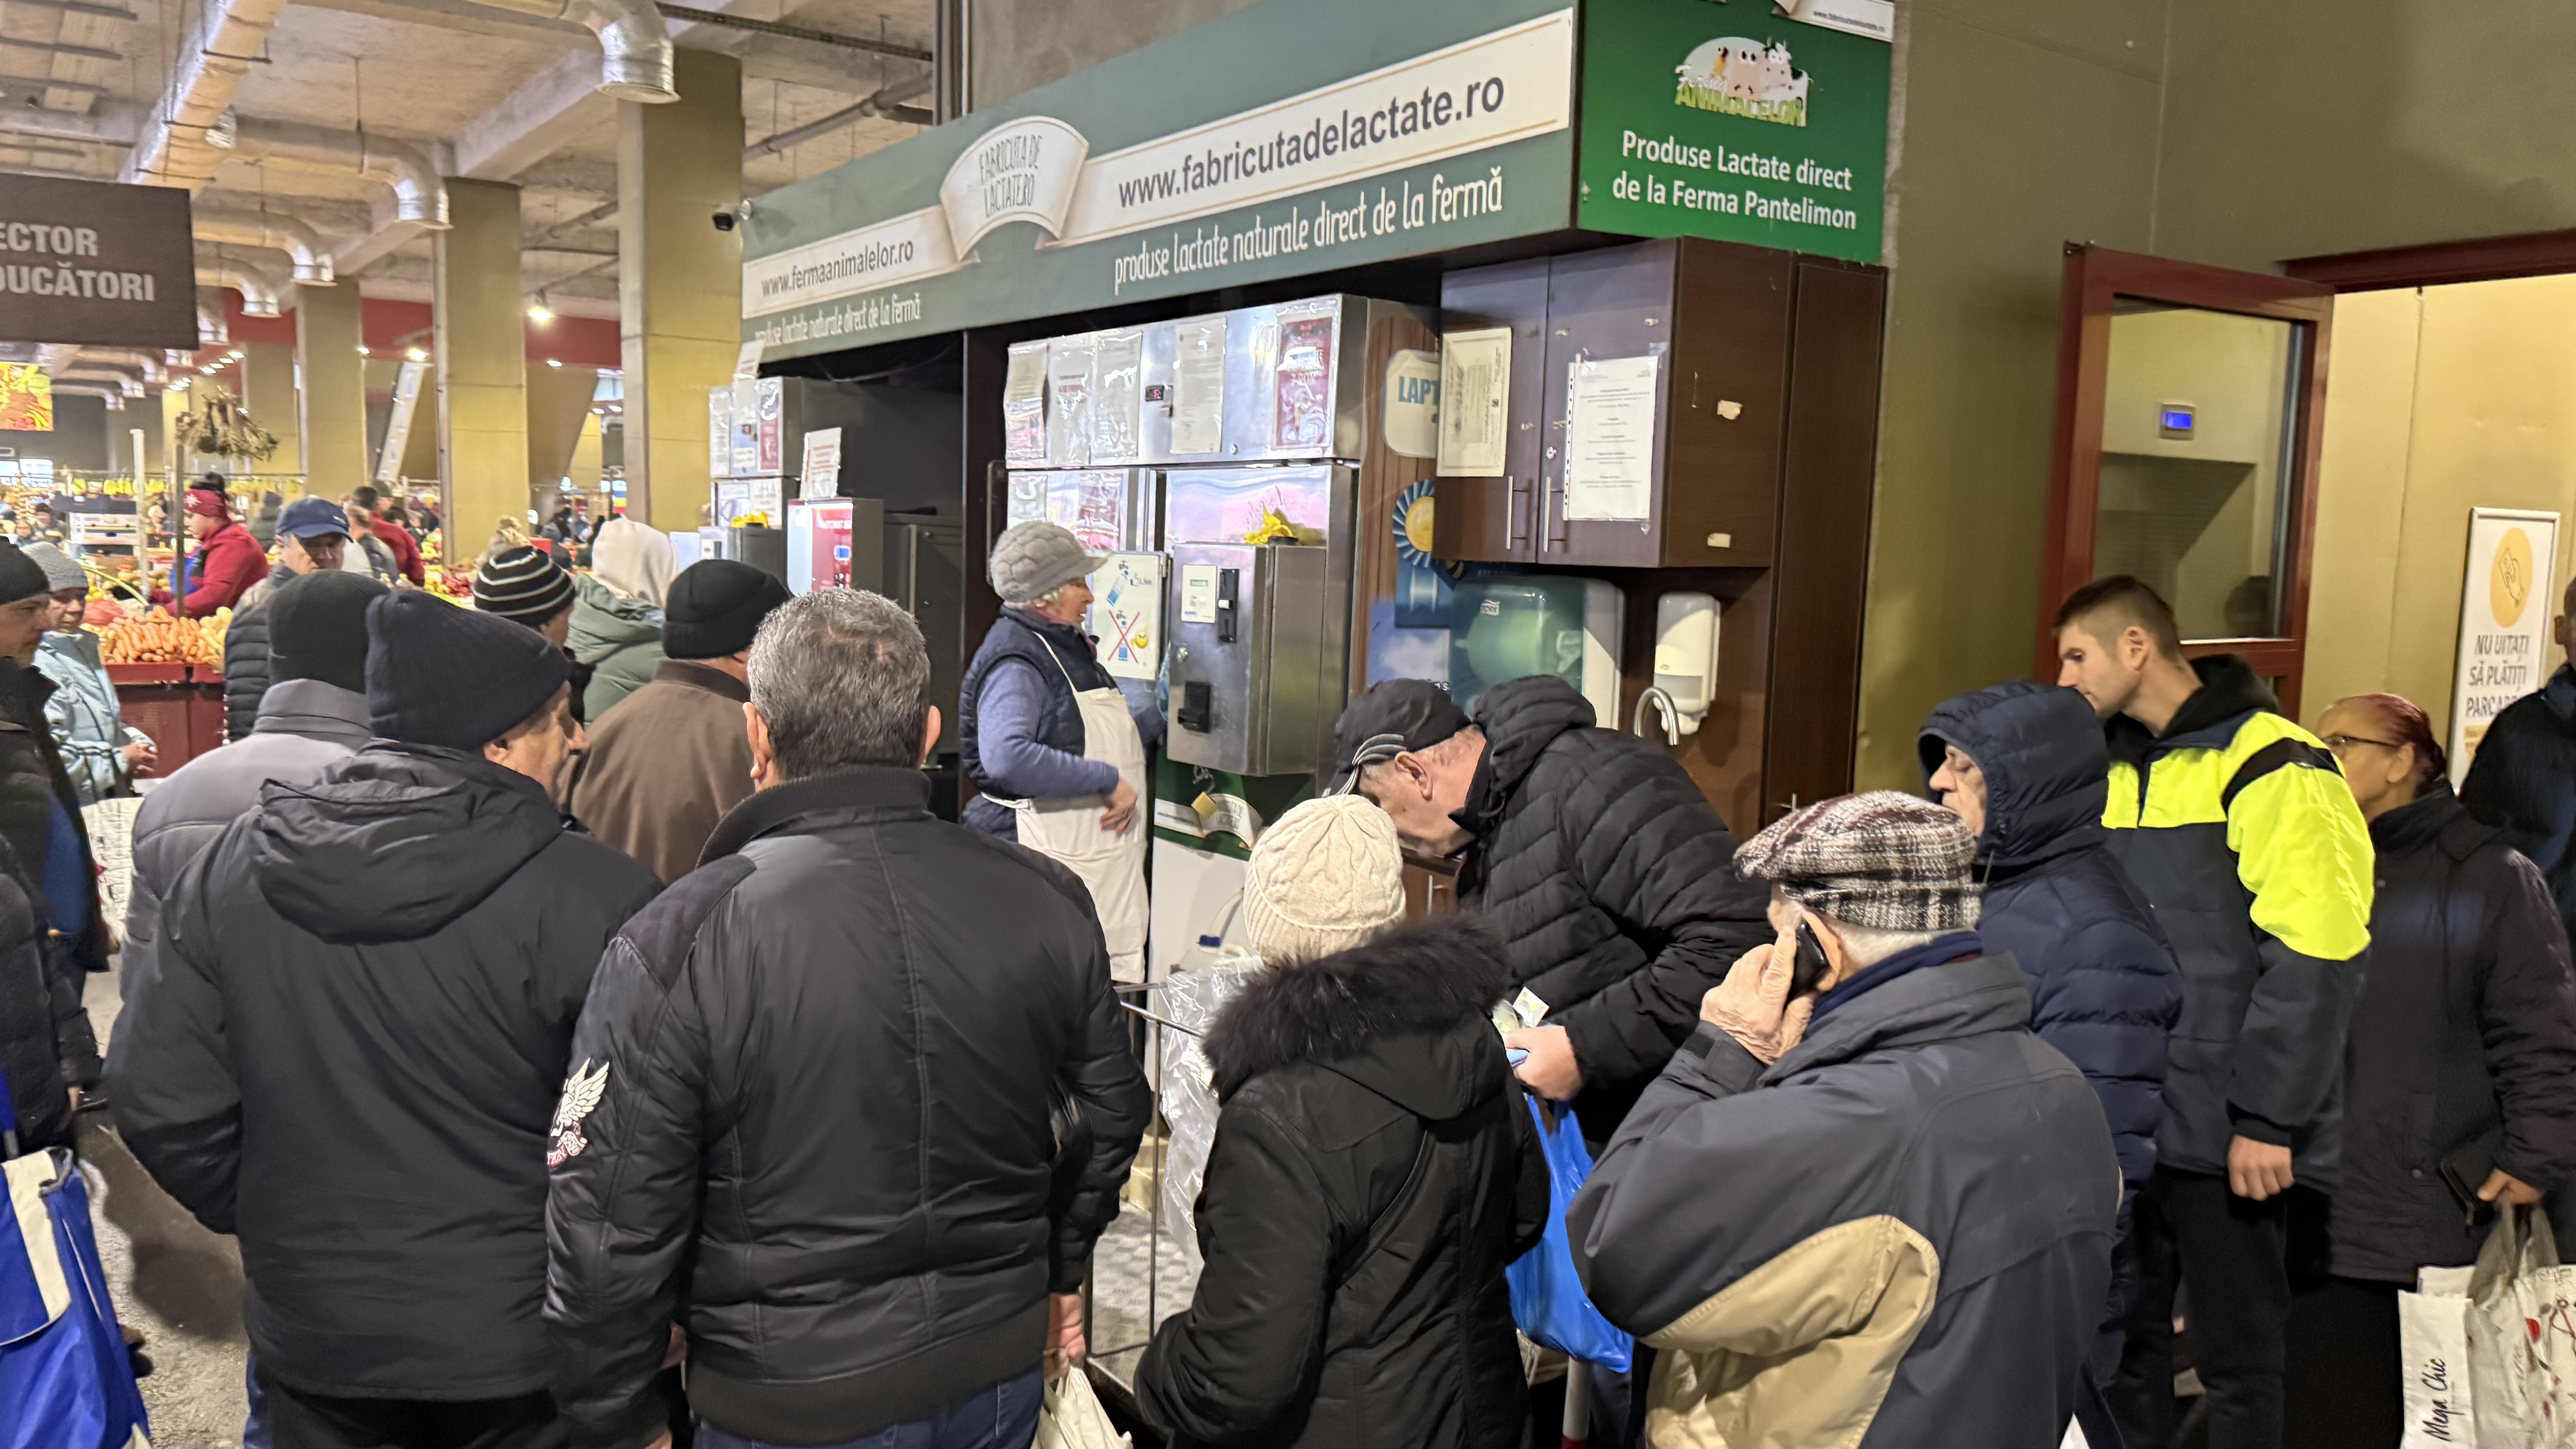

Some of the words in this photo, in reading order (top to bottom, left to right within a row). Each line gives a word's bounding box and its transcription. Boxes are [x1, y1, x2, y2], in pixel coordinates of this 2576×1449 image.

[1119, 77, 1504, 208] www.fabricutadelactate.ro
[1623, 130, 1712, 170] Produse
[1718, 145, 1791, 181] Lactate
[1795, 157, 1853, 191] direct
[1612, 170, 1641, 201] de
[1647, 174, 1666, 204] la
[1673, 179, 1739, 214] Ferma
[1744, 190, 1856, 230] Pantelimon
[1114, 240, 1170, 296] produse
[1174, 224, 1229, 273] lactate
[1233, 206, 1309, 262] naturale
[1313, 200, 1367, 247] direct
[1372, 186, 1396, 236] de
[1403, 180, 1425, 230] la
[1431, 166, 1503, 225] fermă
[761, 240, 914, 296] www.fermaanimalelor.ro
[2468, 660, 2484, 686] SĂ
[2486, 659, 2527, 692] PLĂTIȚI
[2474, 635, 2493, 655] NU
[2494, 635, 2530, 662] UITAȚI
[2420, 1358, 2448, 1391] Chic
[2422, 1399, 2465, 1442] Mega
